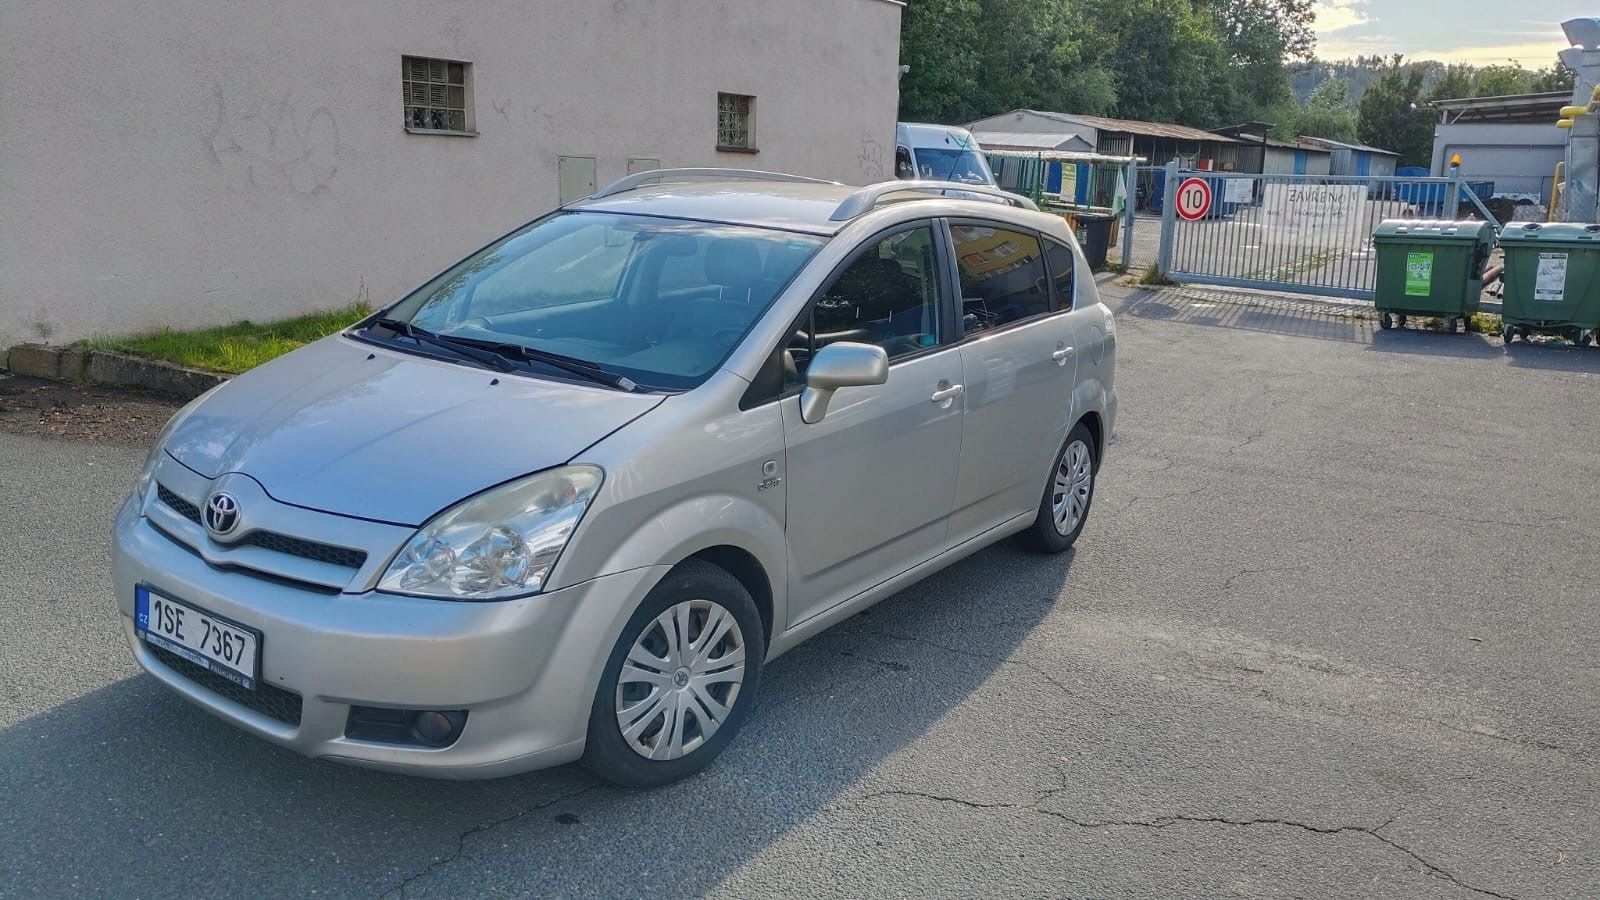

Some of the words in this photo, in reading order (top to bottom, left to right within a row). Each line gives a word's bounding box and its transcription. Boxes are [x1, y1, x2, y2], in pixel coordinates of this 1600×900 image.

[1185, 189, 1203, 209] 10
[139, 613, 148, 624] CZ
[154, 600, 185, 641] 1SE
[200, 618, 246, 666] 7367
